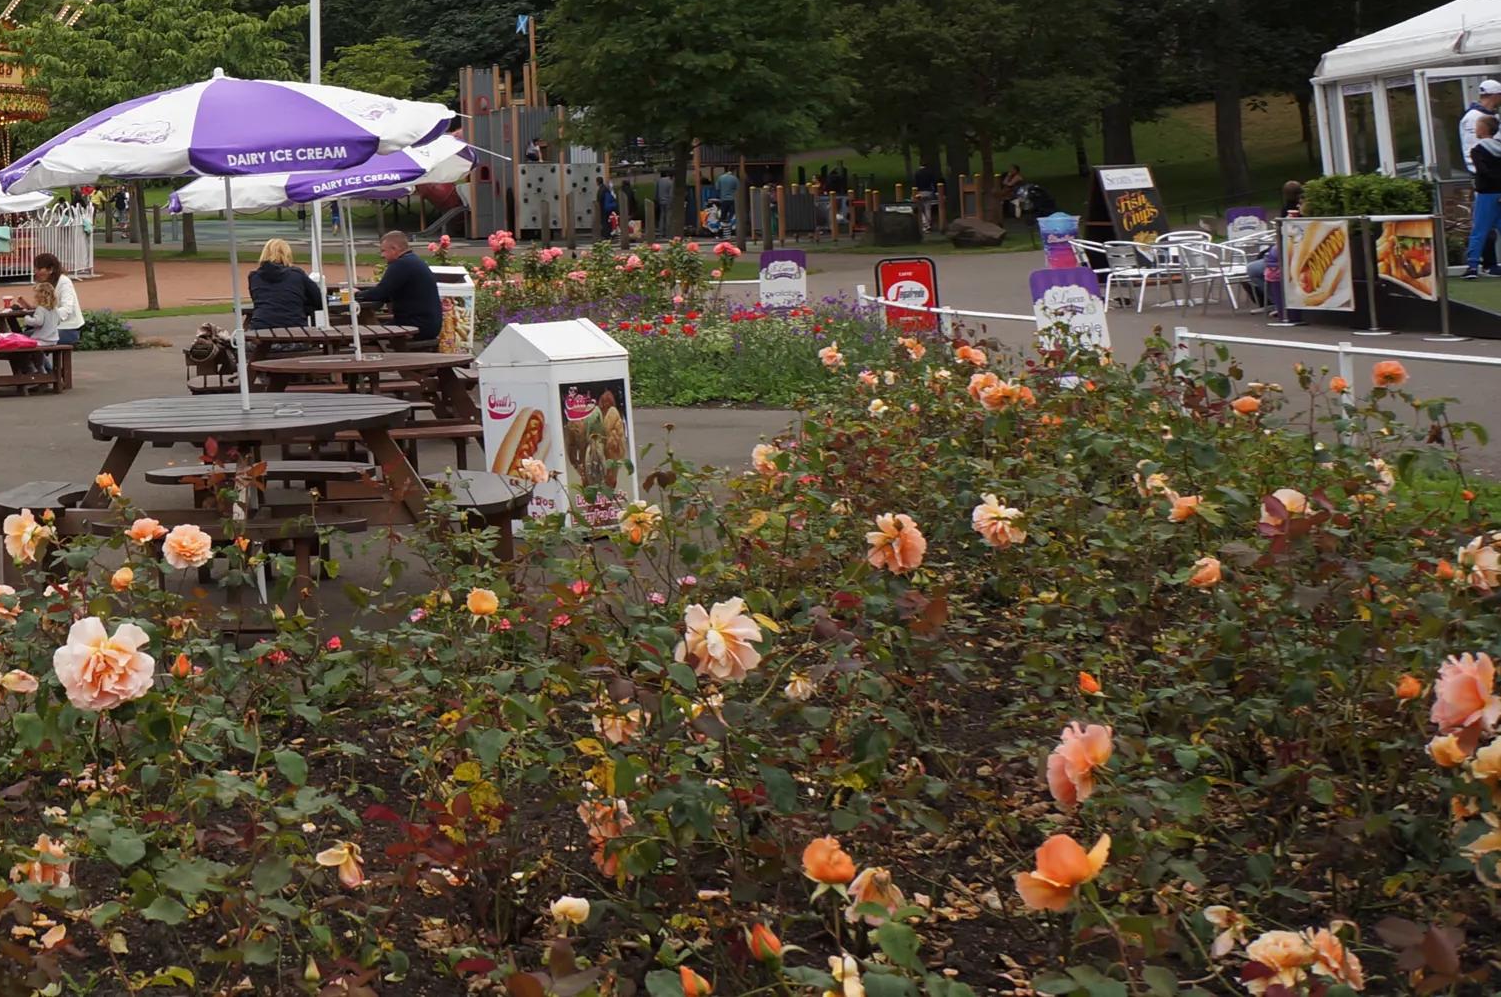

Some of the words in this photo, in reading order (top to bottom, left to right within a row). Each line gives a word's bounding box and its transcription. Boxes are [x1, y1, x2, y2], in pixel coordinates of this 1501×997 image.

[227, 151, 266, 167] DAIRY
[271, 149, 293, 162] ICE
[295, 146, 347, 160] CREAM
[313, 179, 342, 193] DAIRY
[345, 176, 361, 185] ICE
[363, 173, 400, 184] CREAM
[1116, 192, 1148, 213] Fish
[1123, 205, 1158, 232] Chips
